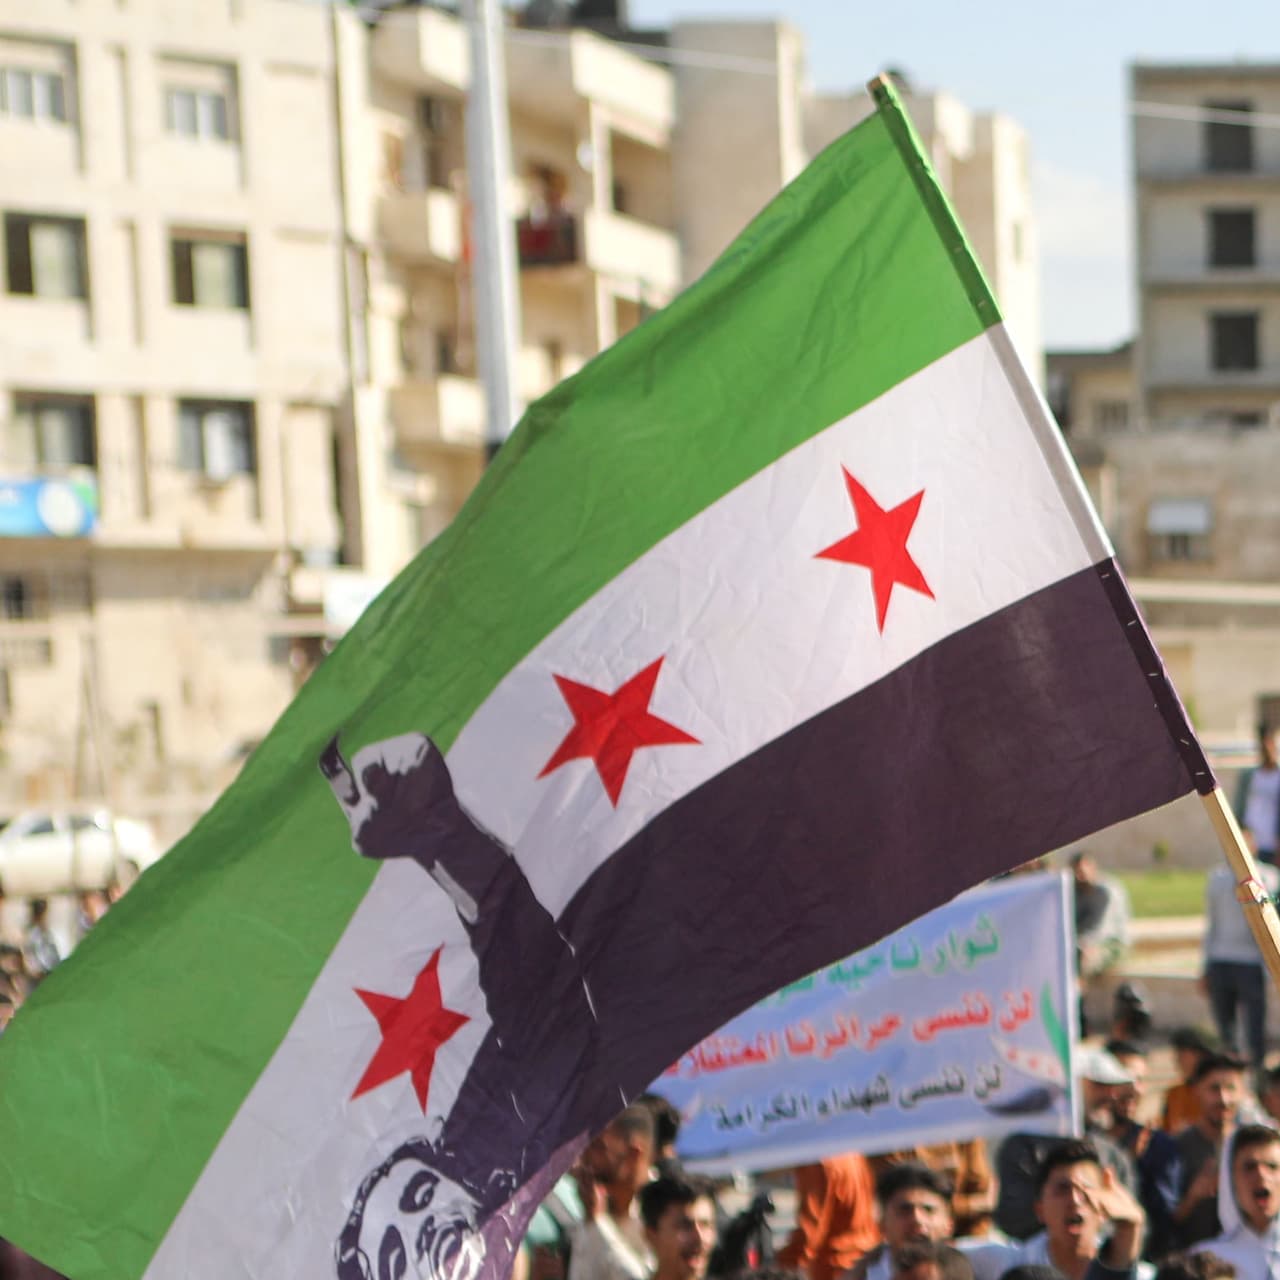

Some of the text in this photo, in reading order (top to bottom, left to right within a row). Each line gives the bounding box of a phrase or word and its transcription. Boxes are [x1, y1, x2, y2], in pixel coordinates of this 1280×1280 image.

[1000, 990, 1034, 1032] لن
[973, 1064, 1002, 1099] لن
[716, 1089, 808, 1133] الكرامة
